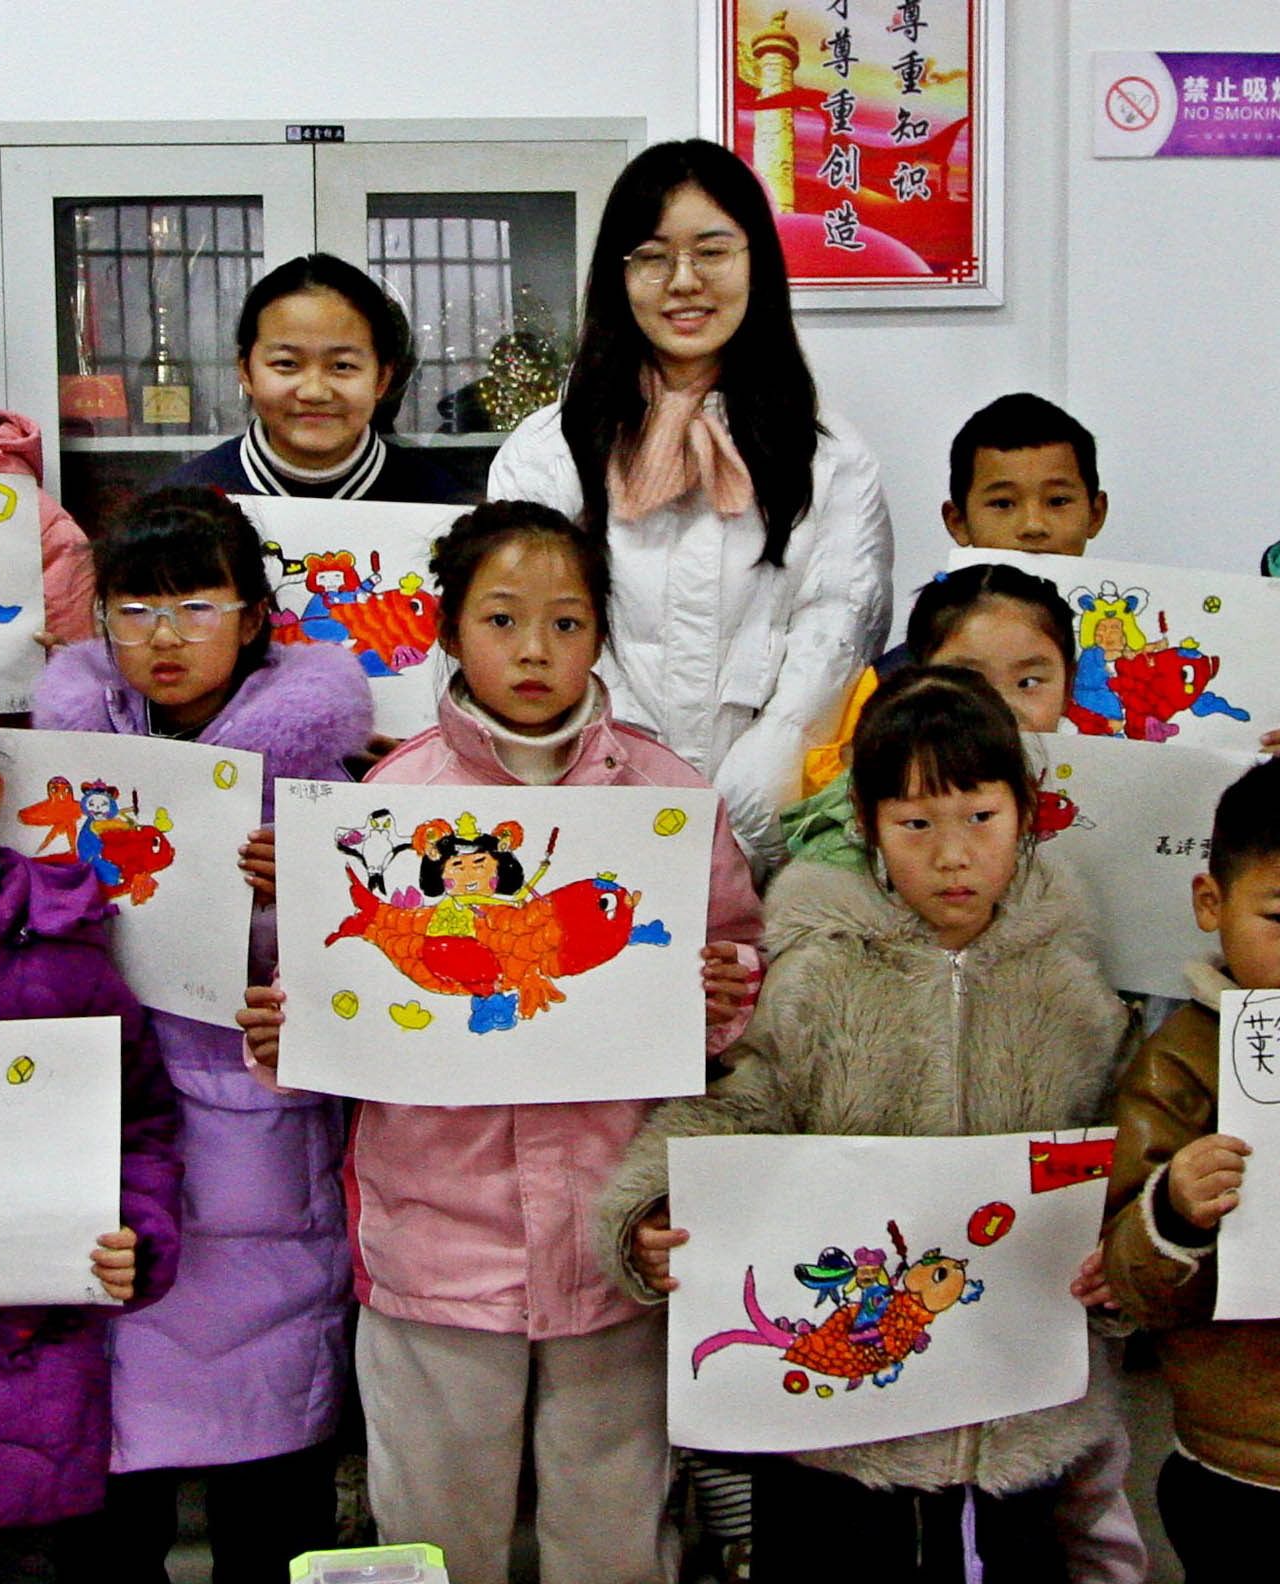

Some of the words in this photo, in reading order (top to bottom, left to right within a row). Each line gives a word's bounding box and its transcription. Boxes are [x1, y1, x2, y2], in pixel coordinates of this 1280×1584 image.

[889, 0, 931, 202] 尊重知识
[1183, 106, 1210, 121] NO
